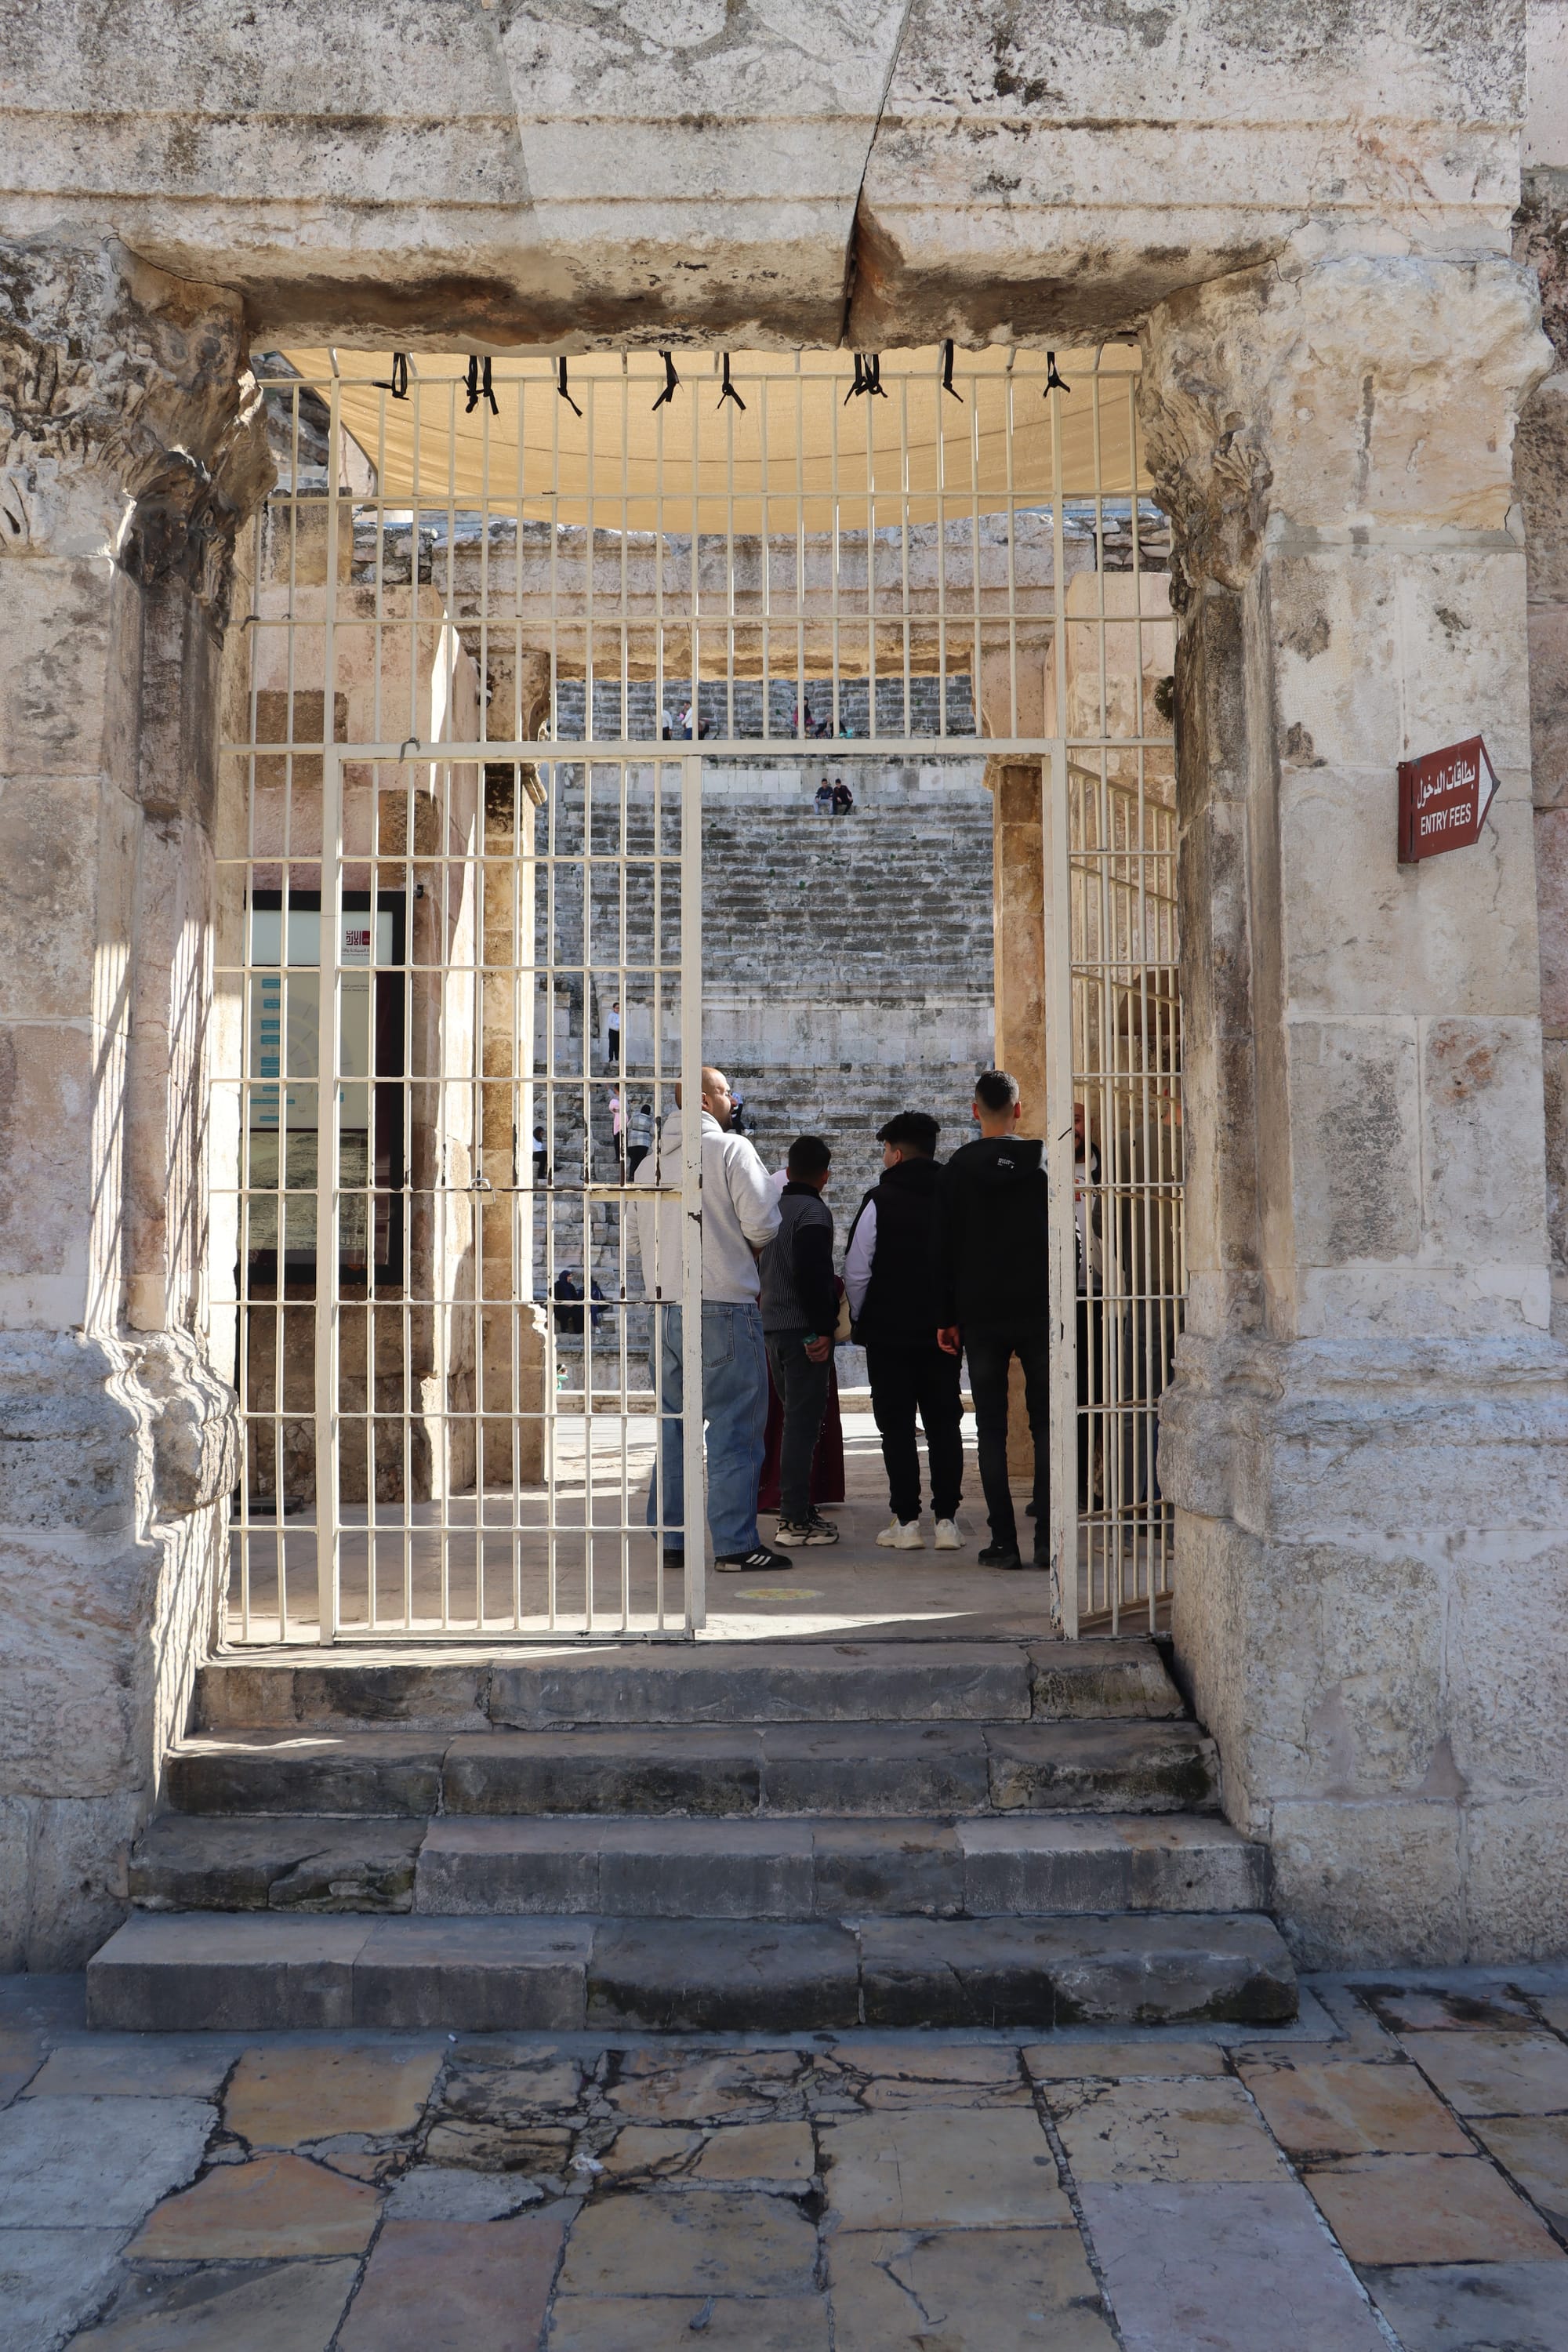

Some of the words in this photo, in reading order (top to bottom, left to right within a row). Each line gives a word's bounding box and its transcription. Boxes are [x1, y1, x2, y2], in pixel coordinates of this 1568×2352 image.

[1417, 771, 1445, 809] الدخول
[1446, 760, 1475, 790] بطاقات
[1421, 809, 1448, 836] ENTRY
[1449, 802, 1472, 828] FEES
